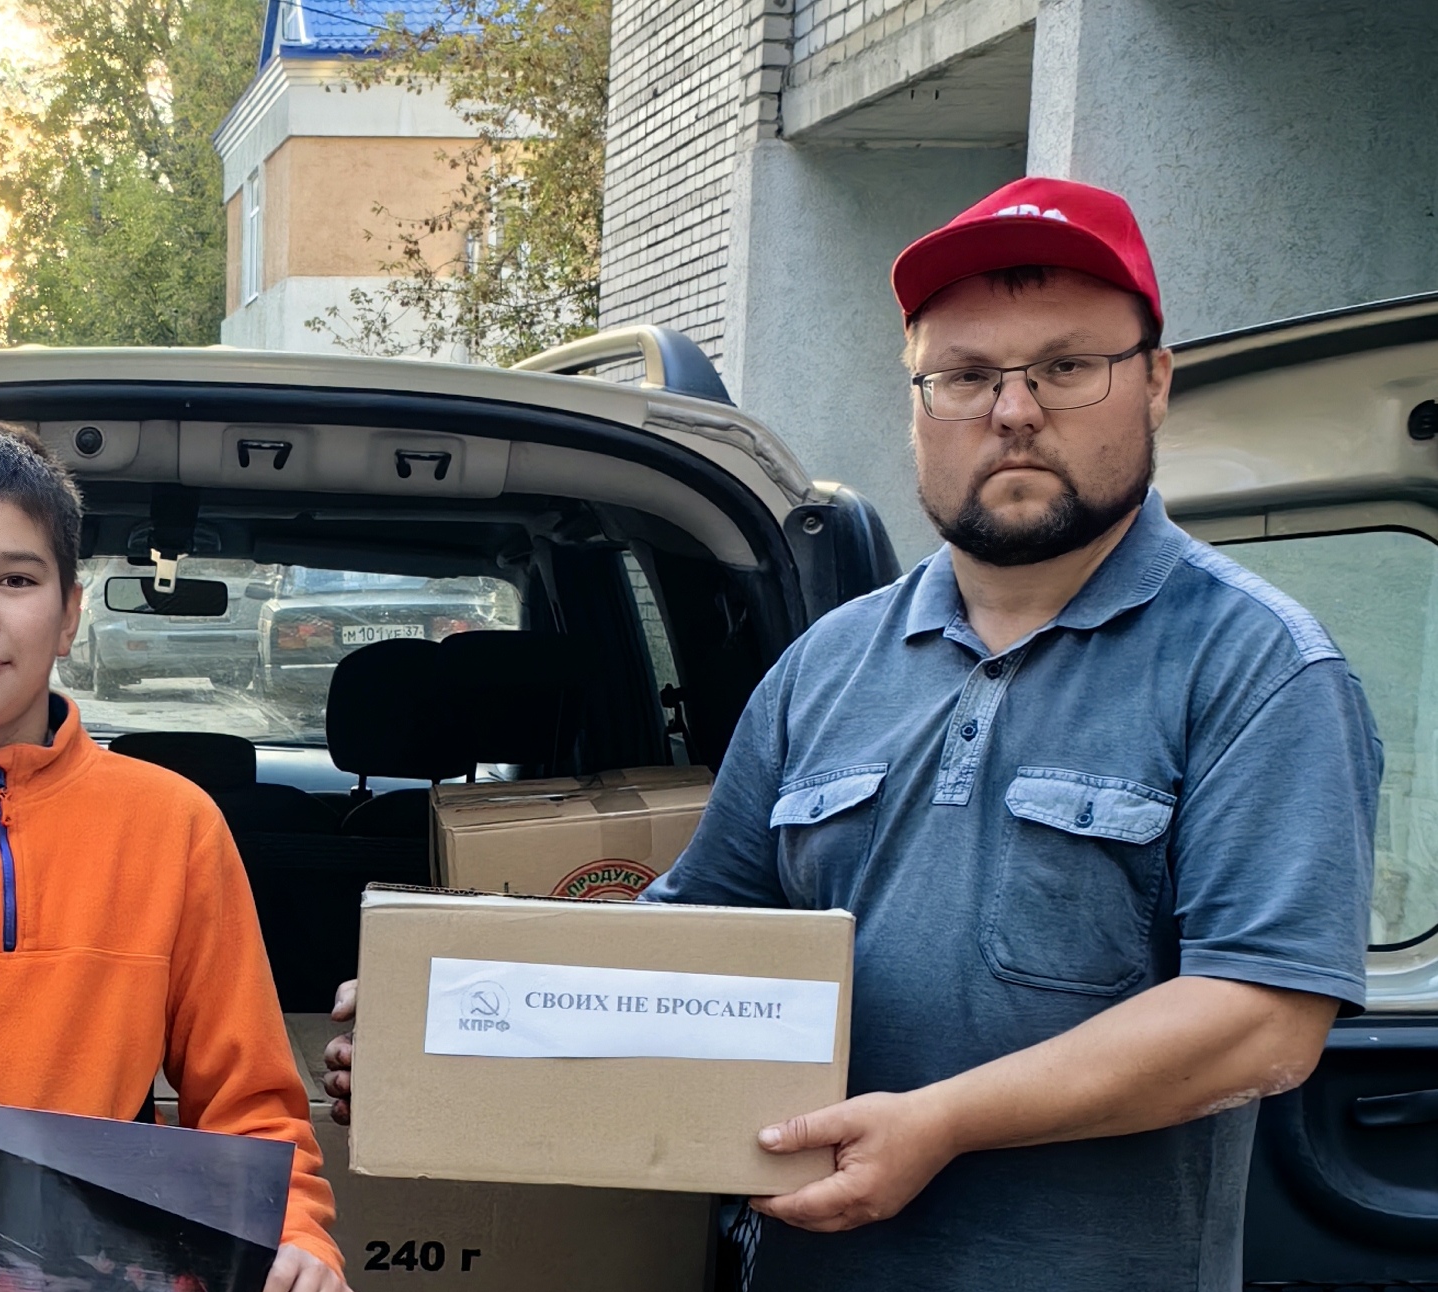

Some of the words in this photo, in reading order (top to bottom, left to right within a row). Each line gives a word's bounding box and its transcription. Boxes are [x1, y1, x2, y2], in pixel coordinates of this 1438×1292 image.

[566, 868, 646, 897] ПРОДУКТ
[525, 991, 609, 1011] СВОИХ
[616, 995, 648, 1013] НЕ
[655, 997, 782, 1019] БРОСАЕМ!
[458, 1018, 511, 1032] КПРФ
[364, 1240, 445, 1271] 240
[461, 1249, 481, 1271] г
